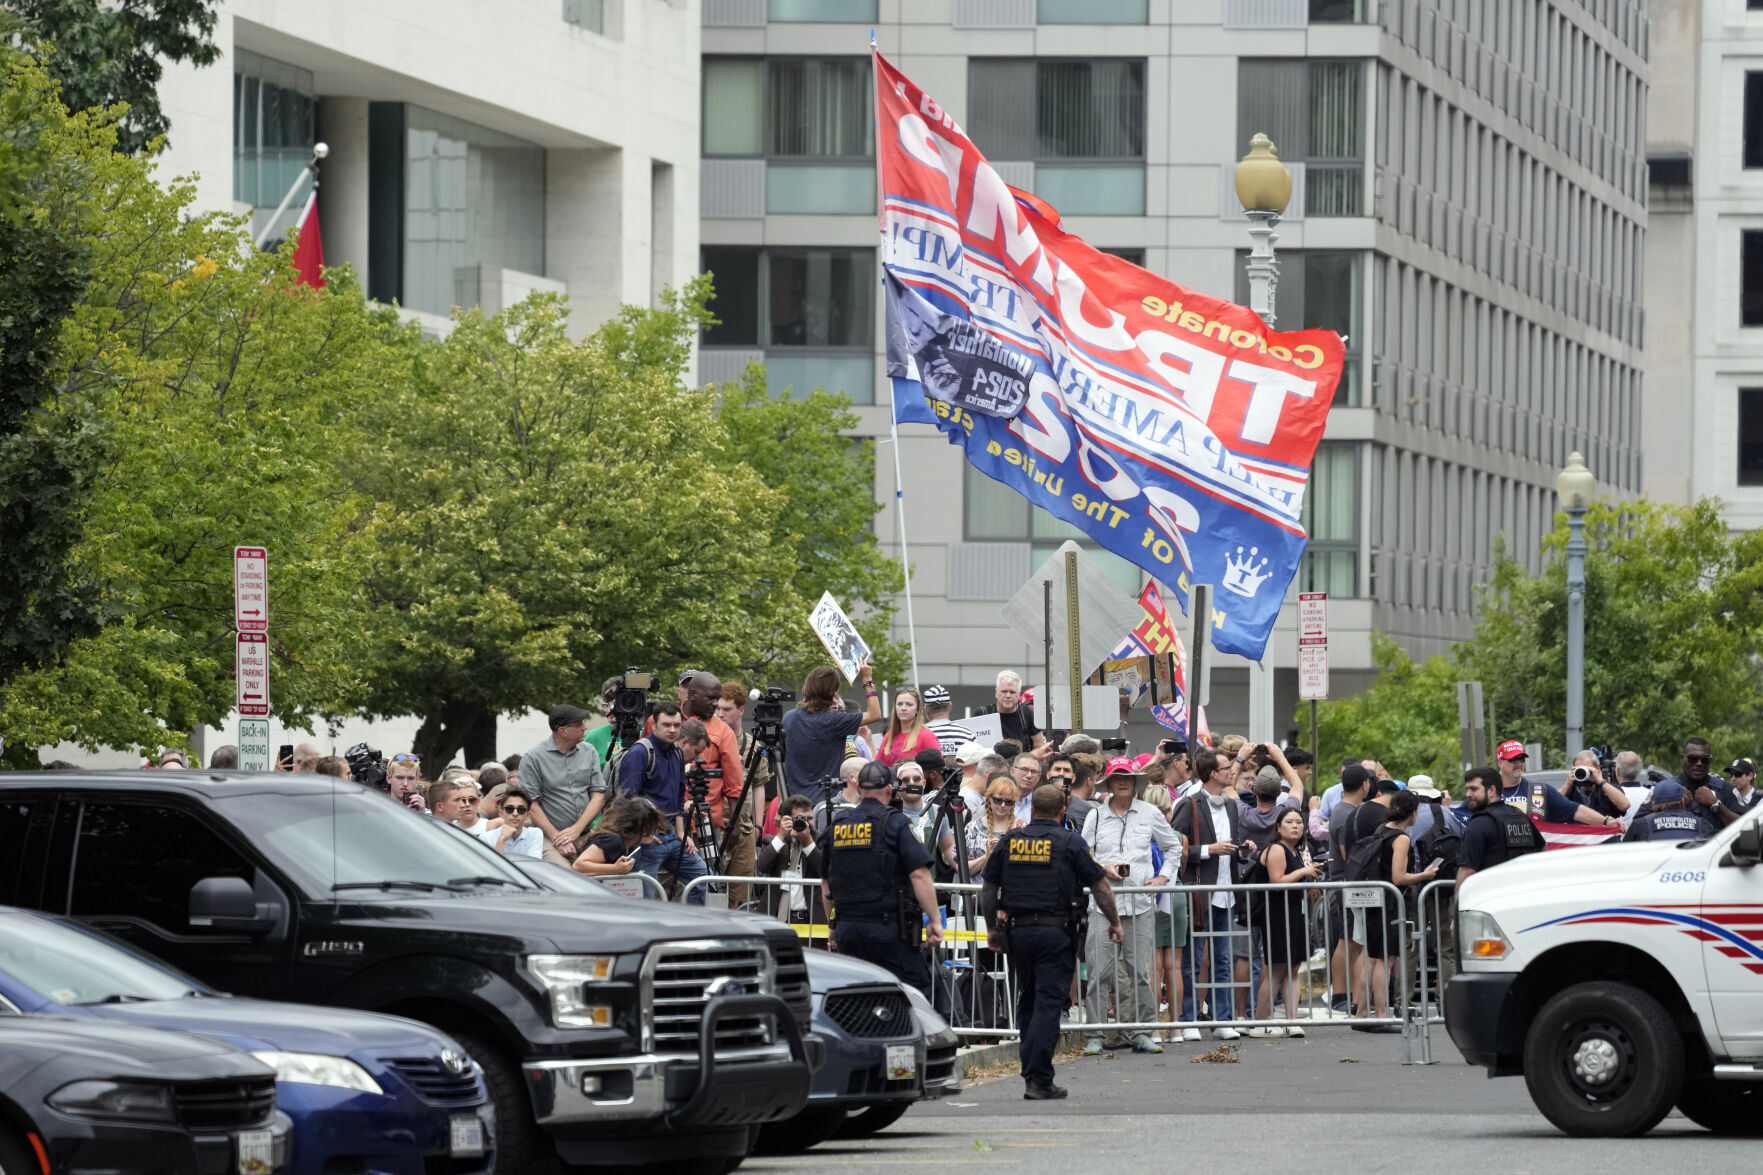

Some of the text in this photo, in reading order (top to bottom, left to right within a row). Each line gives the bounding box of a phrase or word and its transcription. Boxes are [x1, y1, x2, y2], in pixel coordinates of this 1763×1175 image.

[240, 572, 262, 580] STANDING
[246, 582, 263, 590] PARKING
[248, 646, 256, 655] US
[242, 668, 264, 678] PARKING
[246, 680, 259, 689] ONLY
[241, 726, 266, 737] BACK-IN
[976, 729, 992, 738] TIME
[241, 744, 266, 755] PARKING
[1653, 816, 1697, 825] METROPOLITAN
[833, 822, 872, 840] POLICE
[1507, 823, 1532, 837] POLICE
[1009, 838, 1052, 855] POLICE
[1659, 871, 1706, 883] 8608
